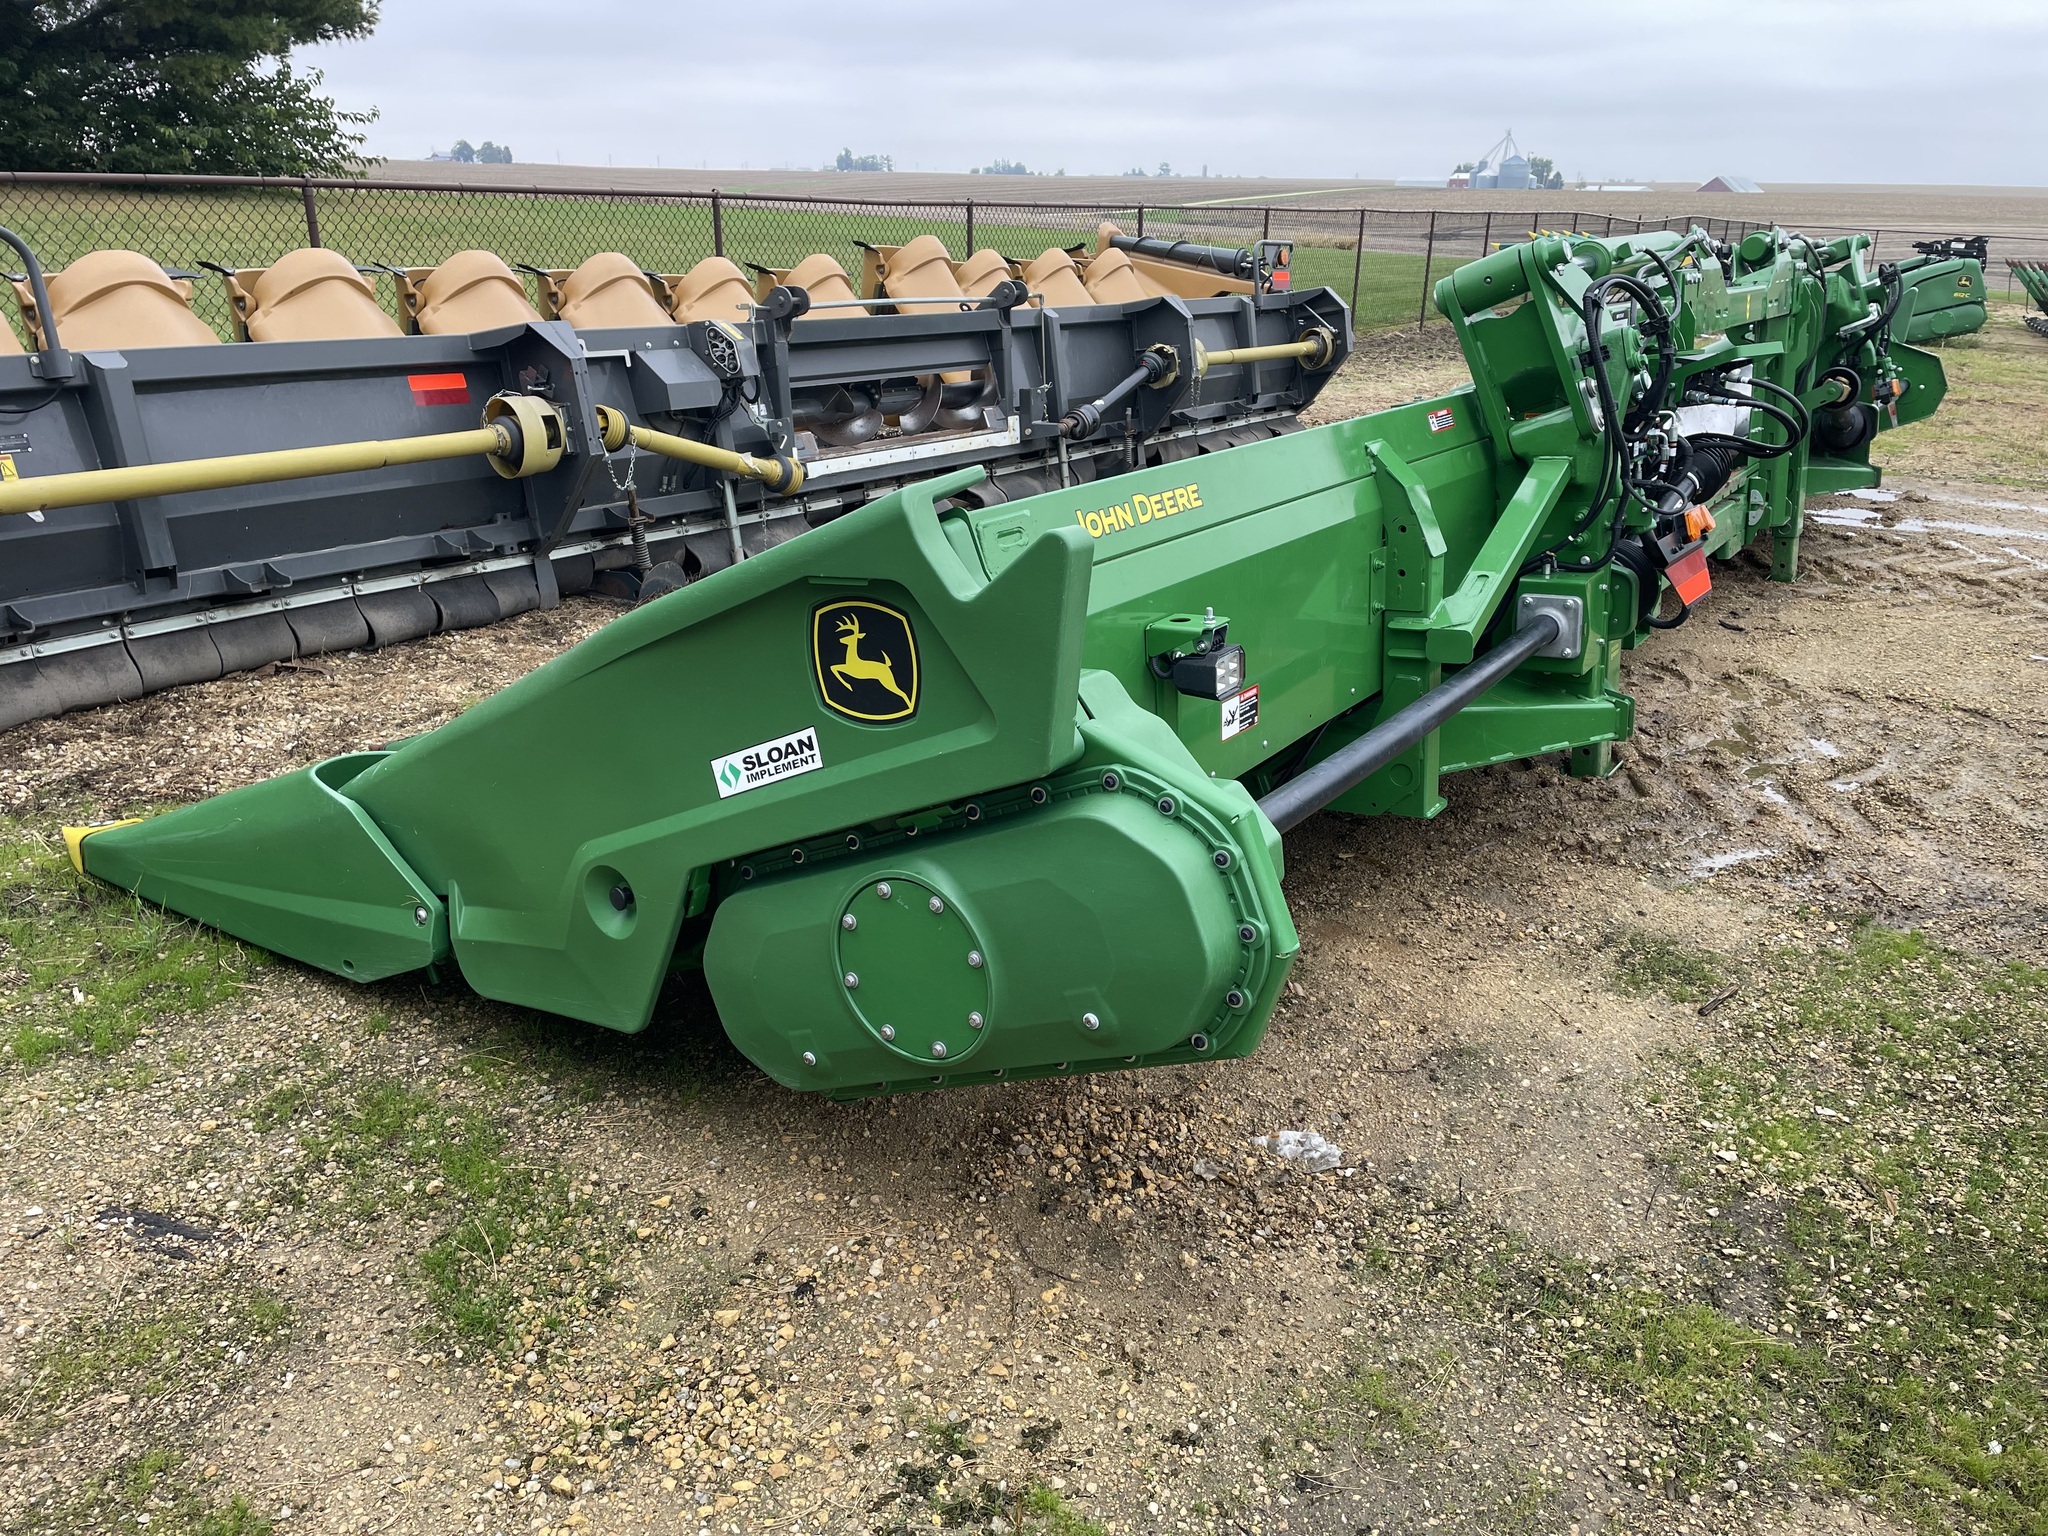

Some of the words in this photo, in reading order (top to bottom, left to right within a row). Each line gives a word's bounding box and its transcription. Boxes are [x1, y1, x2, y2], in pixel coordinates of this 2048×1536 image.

[1075, 502, 1136, 539] JOHN
[1131, 482, 1204, 525] DEERE
[742, 735, 815, 772] SLOAN
[746, 753, 817, 784] IMPLEMENT
